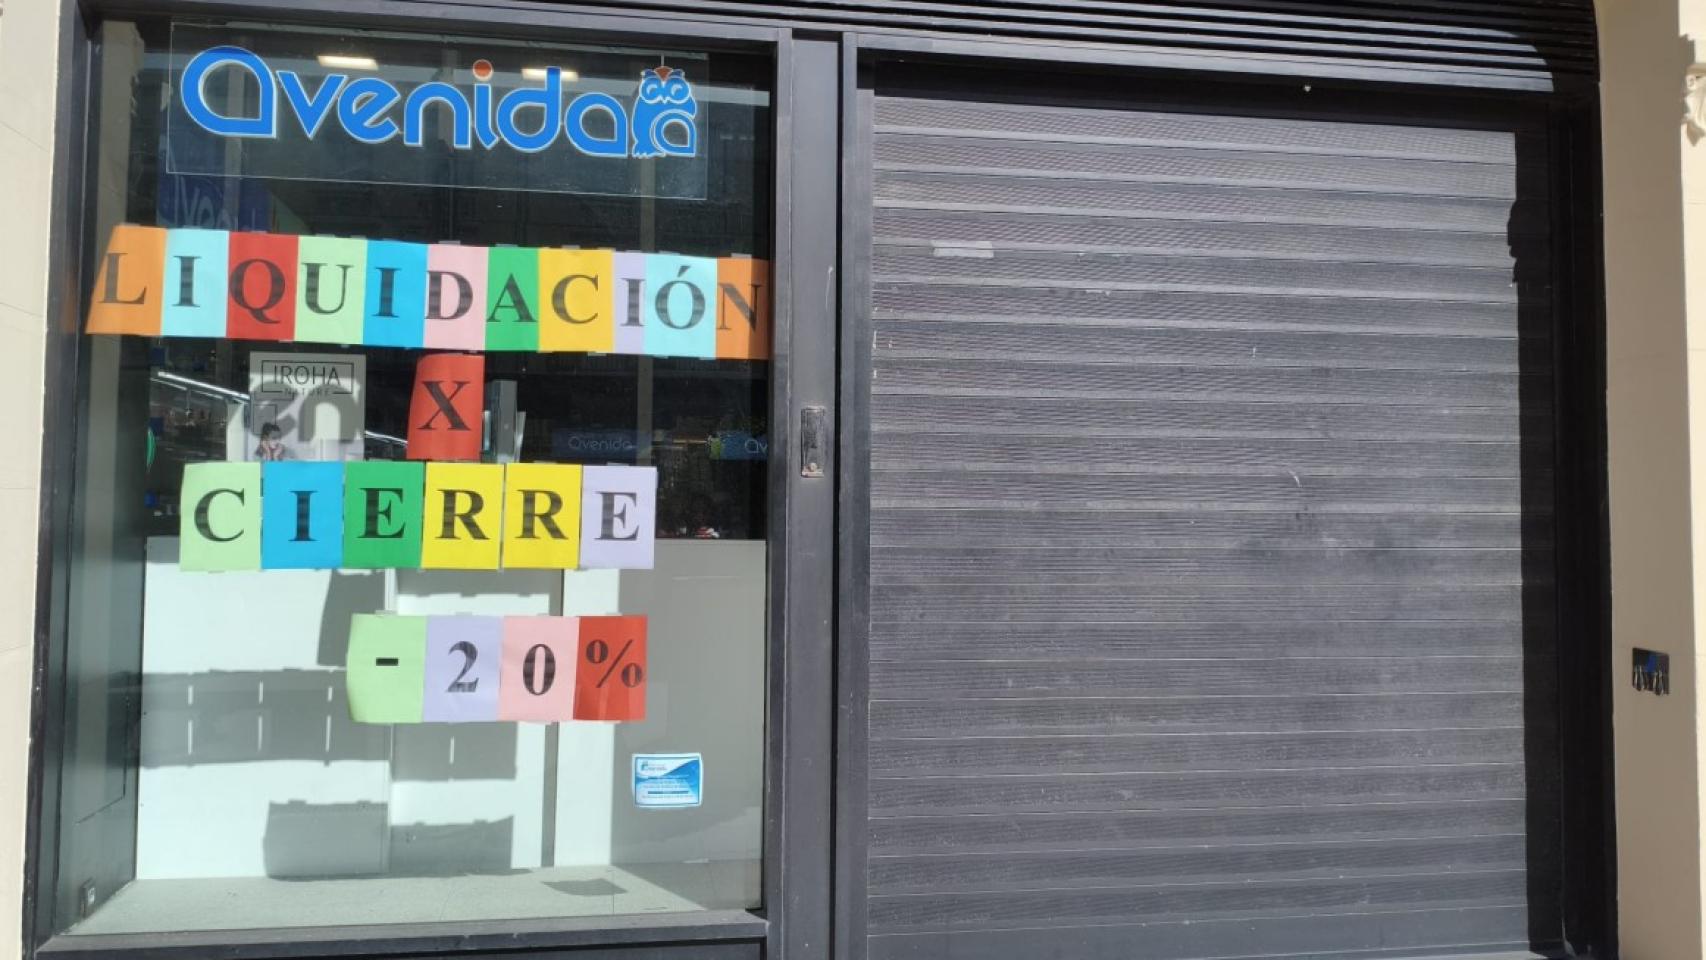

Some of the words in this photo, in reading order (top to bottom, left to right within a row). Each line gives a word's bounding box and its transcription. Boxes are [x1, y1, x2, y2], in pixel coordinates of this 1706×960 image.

[181, 45, 628, 158] avenida
[98, 252, 764, 333] LIQUIDACIÓN
[273, 365, 341, 385] IROHA
[416, 380, 472, 432] X
[194, 488, 640, 541] CIERRE
